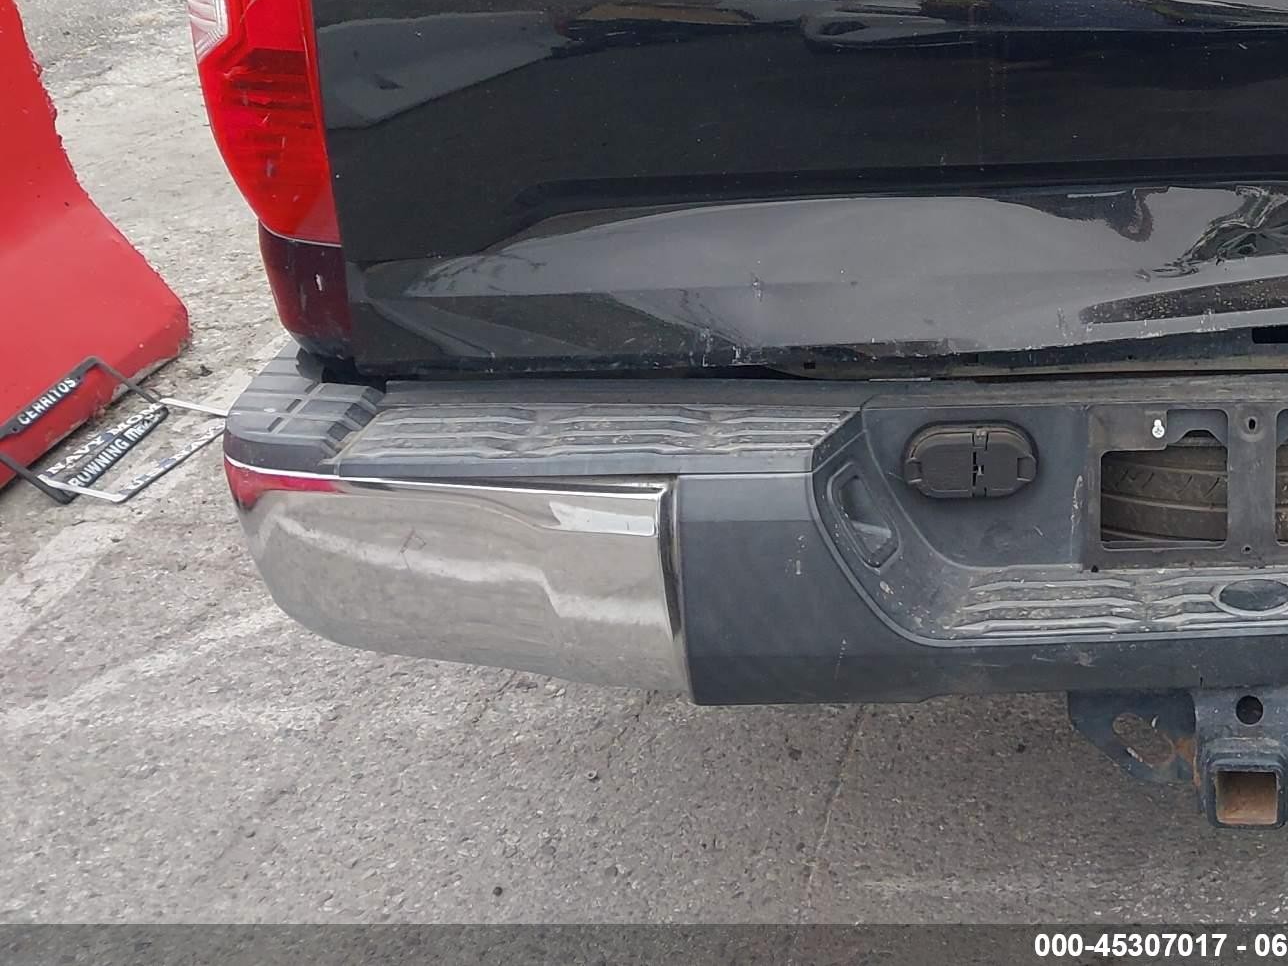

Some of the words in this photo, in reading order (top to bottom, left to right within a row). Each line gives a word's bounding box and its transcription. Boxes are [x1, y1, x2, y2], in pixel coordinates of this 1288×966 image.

[17, 377, 77, 425] CERRITOS
[45, 436, 104, 474] NAVY
[106, 403, 162, 436] MOM
